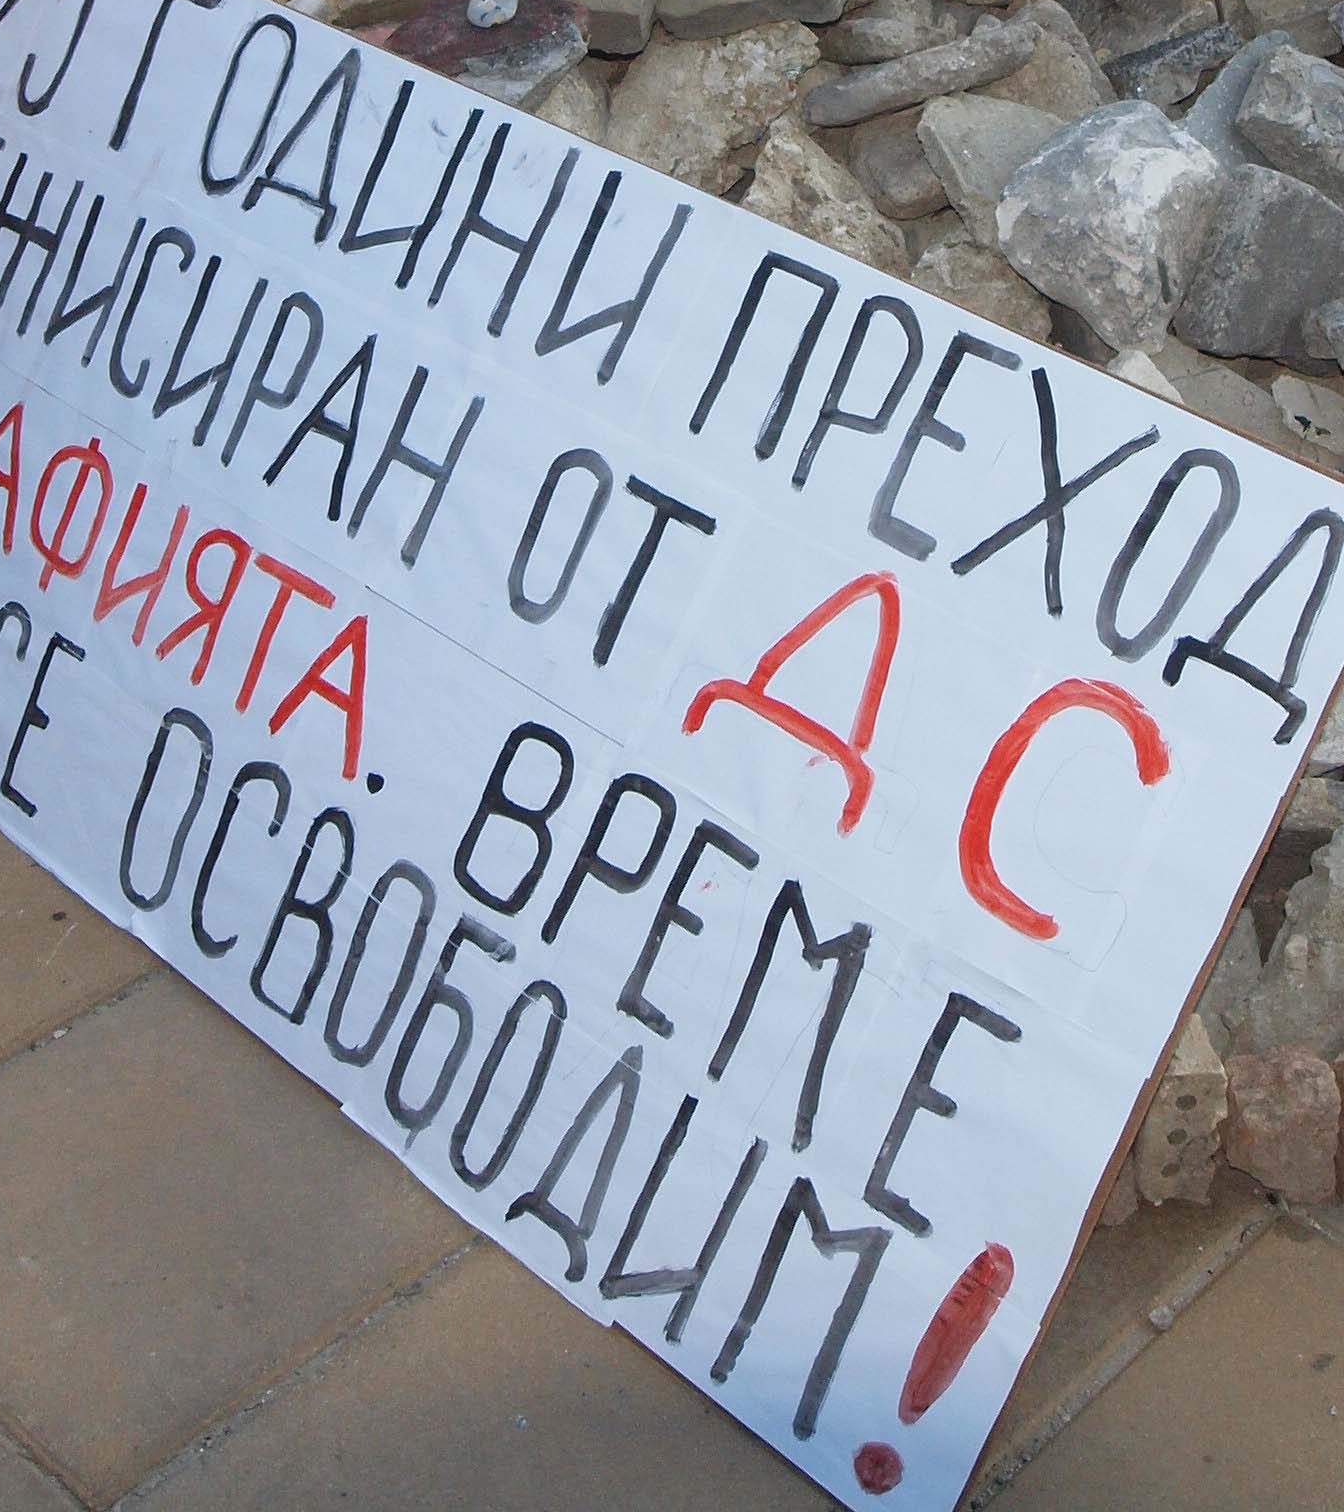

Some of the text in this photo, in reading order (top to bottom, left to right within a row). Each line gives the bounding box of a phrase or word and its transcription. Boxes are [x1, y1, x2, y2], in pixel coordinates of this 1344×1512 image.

[507, 447, 718, 669] ОТ
[119, 706, 1015, 1496] ОСВОБОДИМ!
[452, 720, 1023, 1239] ВРЕМЕ
